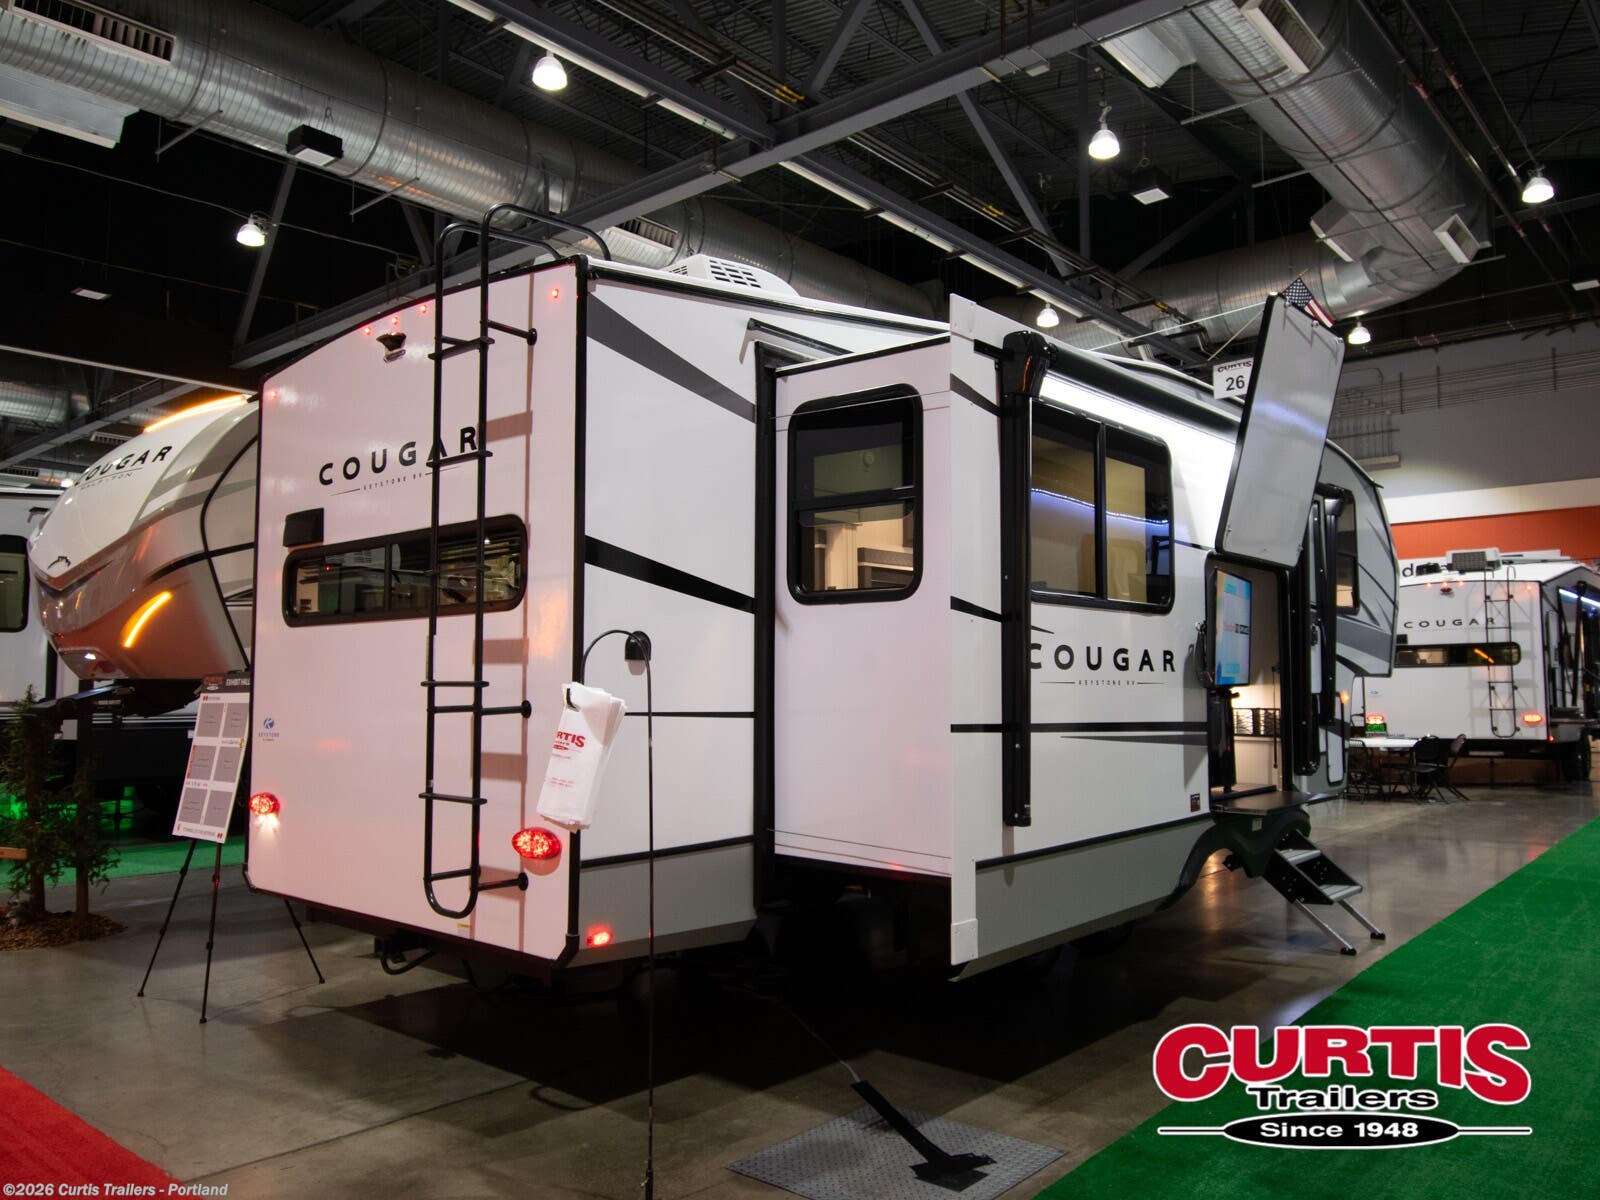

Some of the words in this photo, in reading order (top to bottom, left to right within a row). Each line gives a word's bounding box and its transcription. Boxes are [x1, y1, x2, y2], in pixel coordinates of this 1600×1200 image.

[1217, 361, 1252, 373] CURTIS
[1225, 375, 1245, 391] 26
[318, 426, 478, 486] COUGAR
[1404, 618, 1495, 629] COUGAR
[556, 731, 586, 748] RTIS
